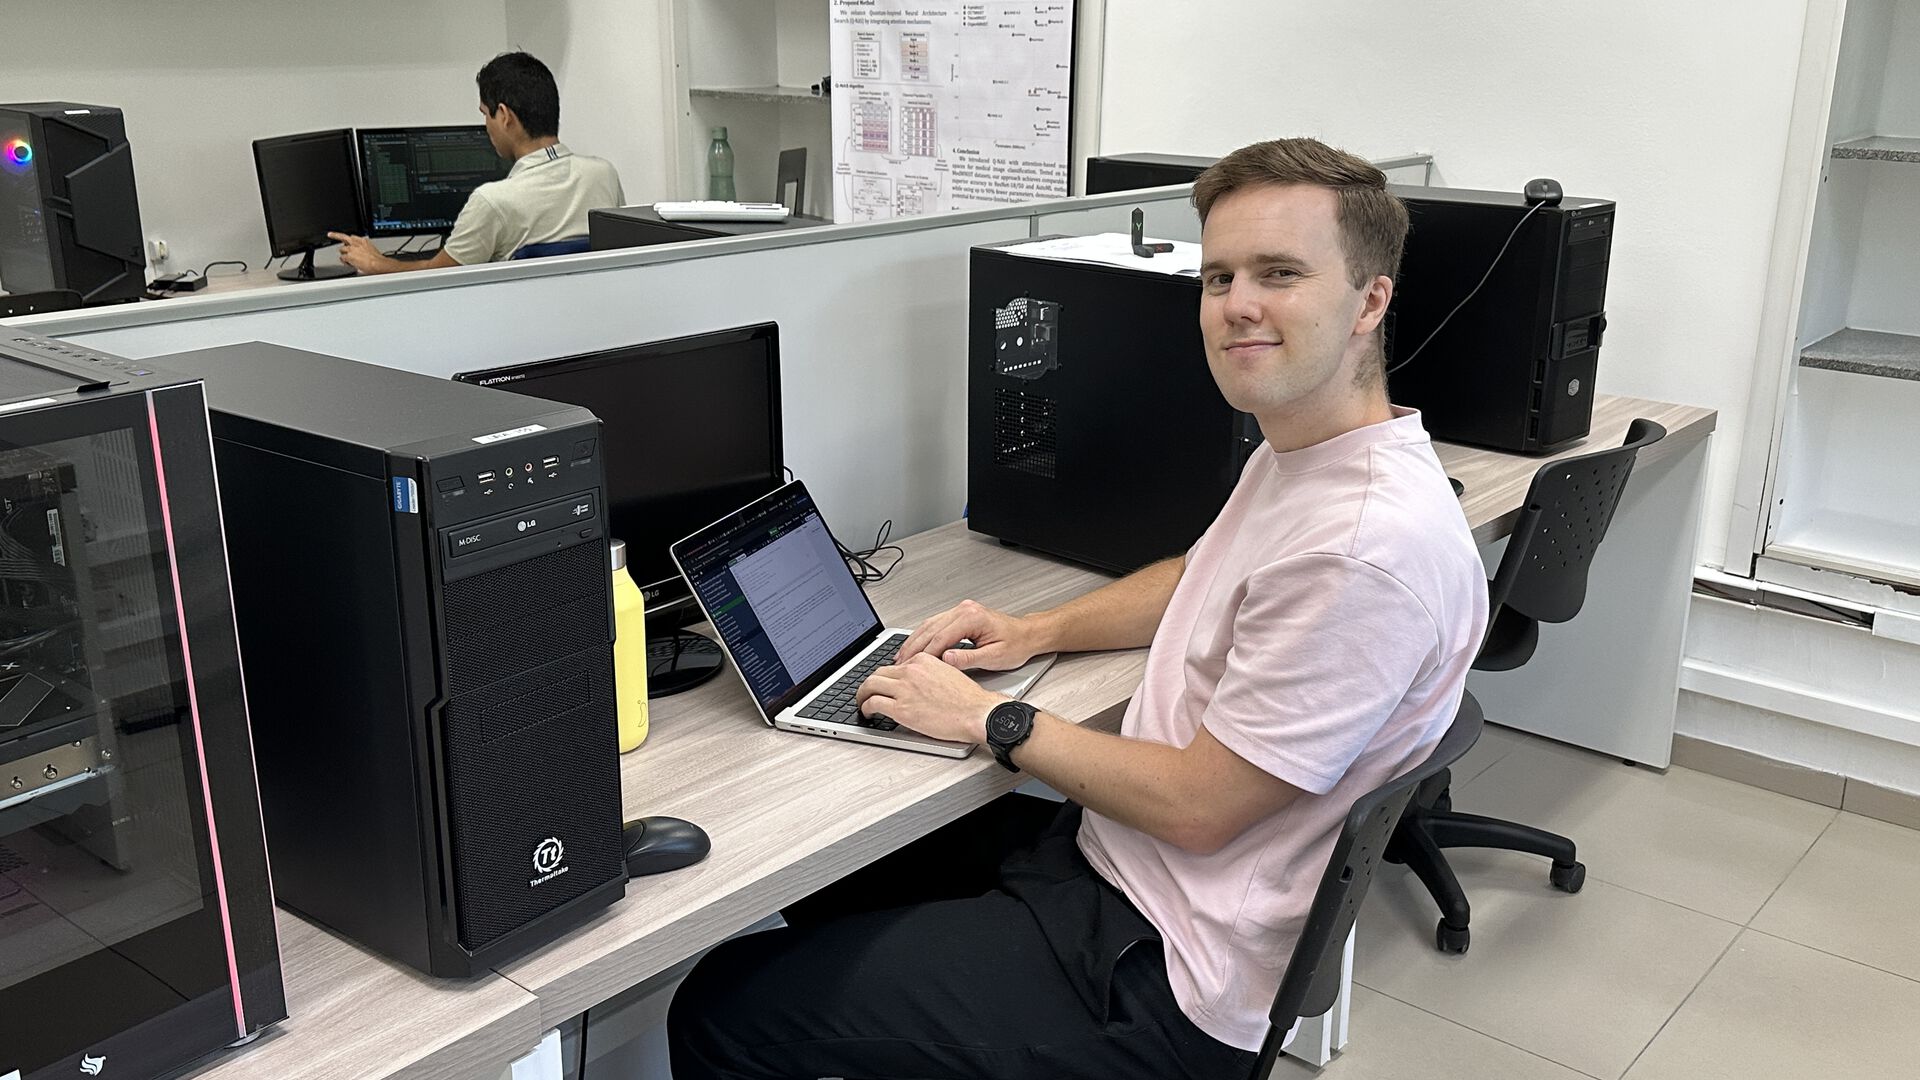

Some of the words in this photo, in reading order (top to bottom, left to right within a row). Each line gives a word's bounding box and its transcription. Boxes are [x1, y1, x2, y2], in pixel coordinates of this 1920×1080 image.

[1136, 223, 1142, 231] Y
[479, 376, 510, 386] FLATRON
[541, 845, 557, 864] Tt
[530, 867, 568, 887] Thermaltake
